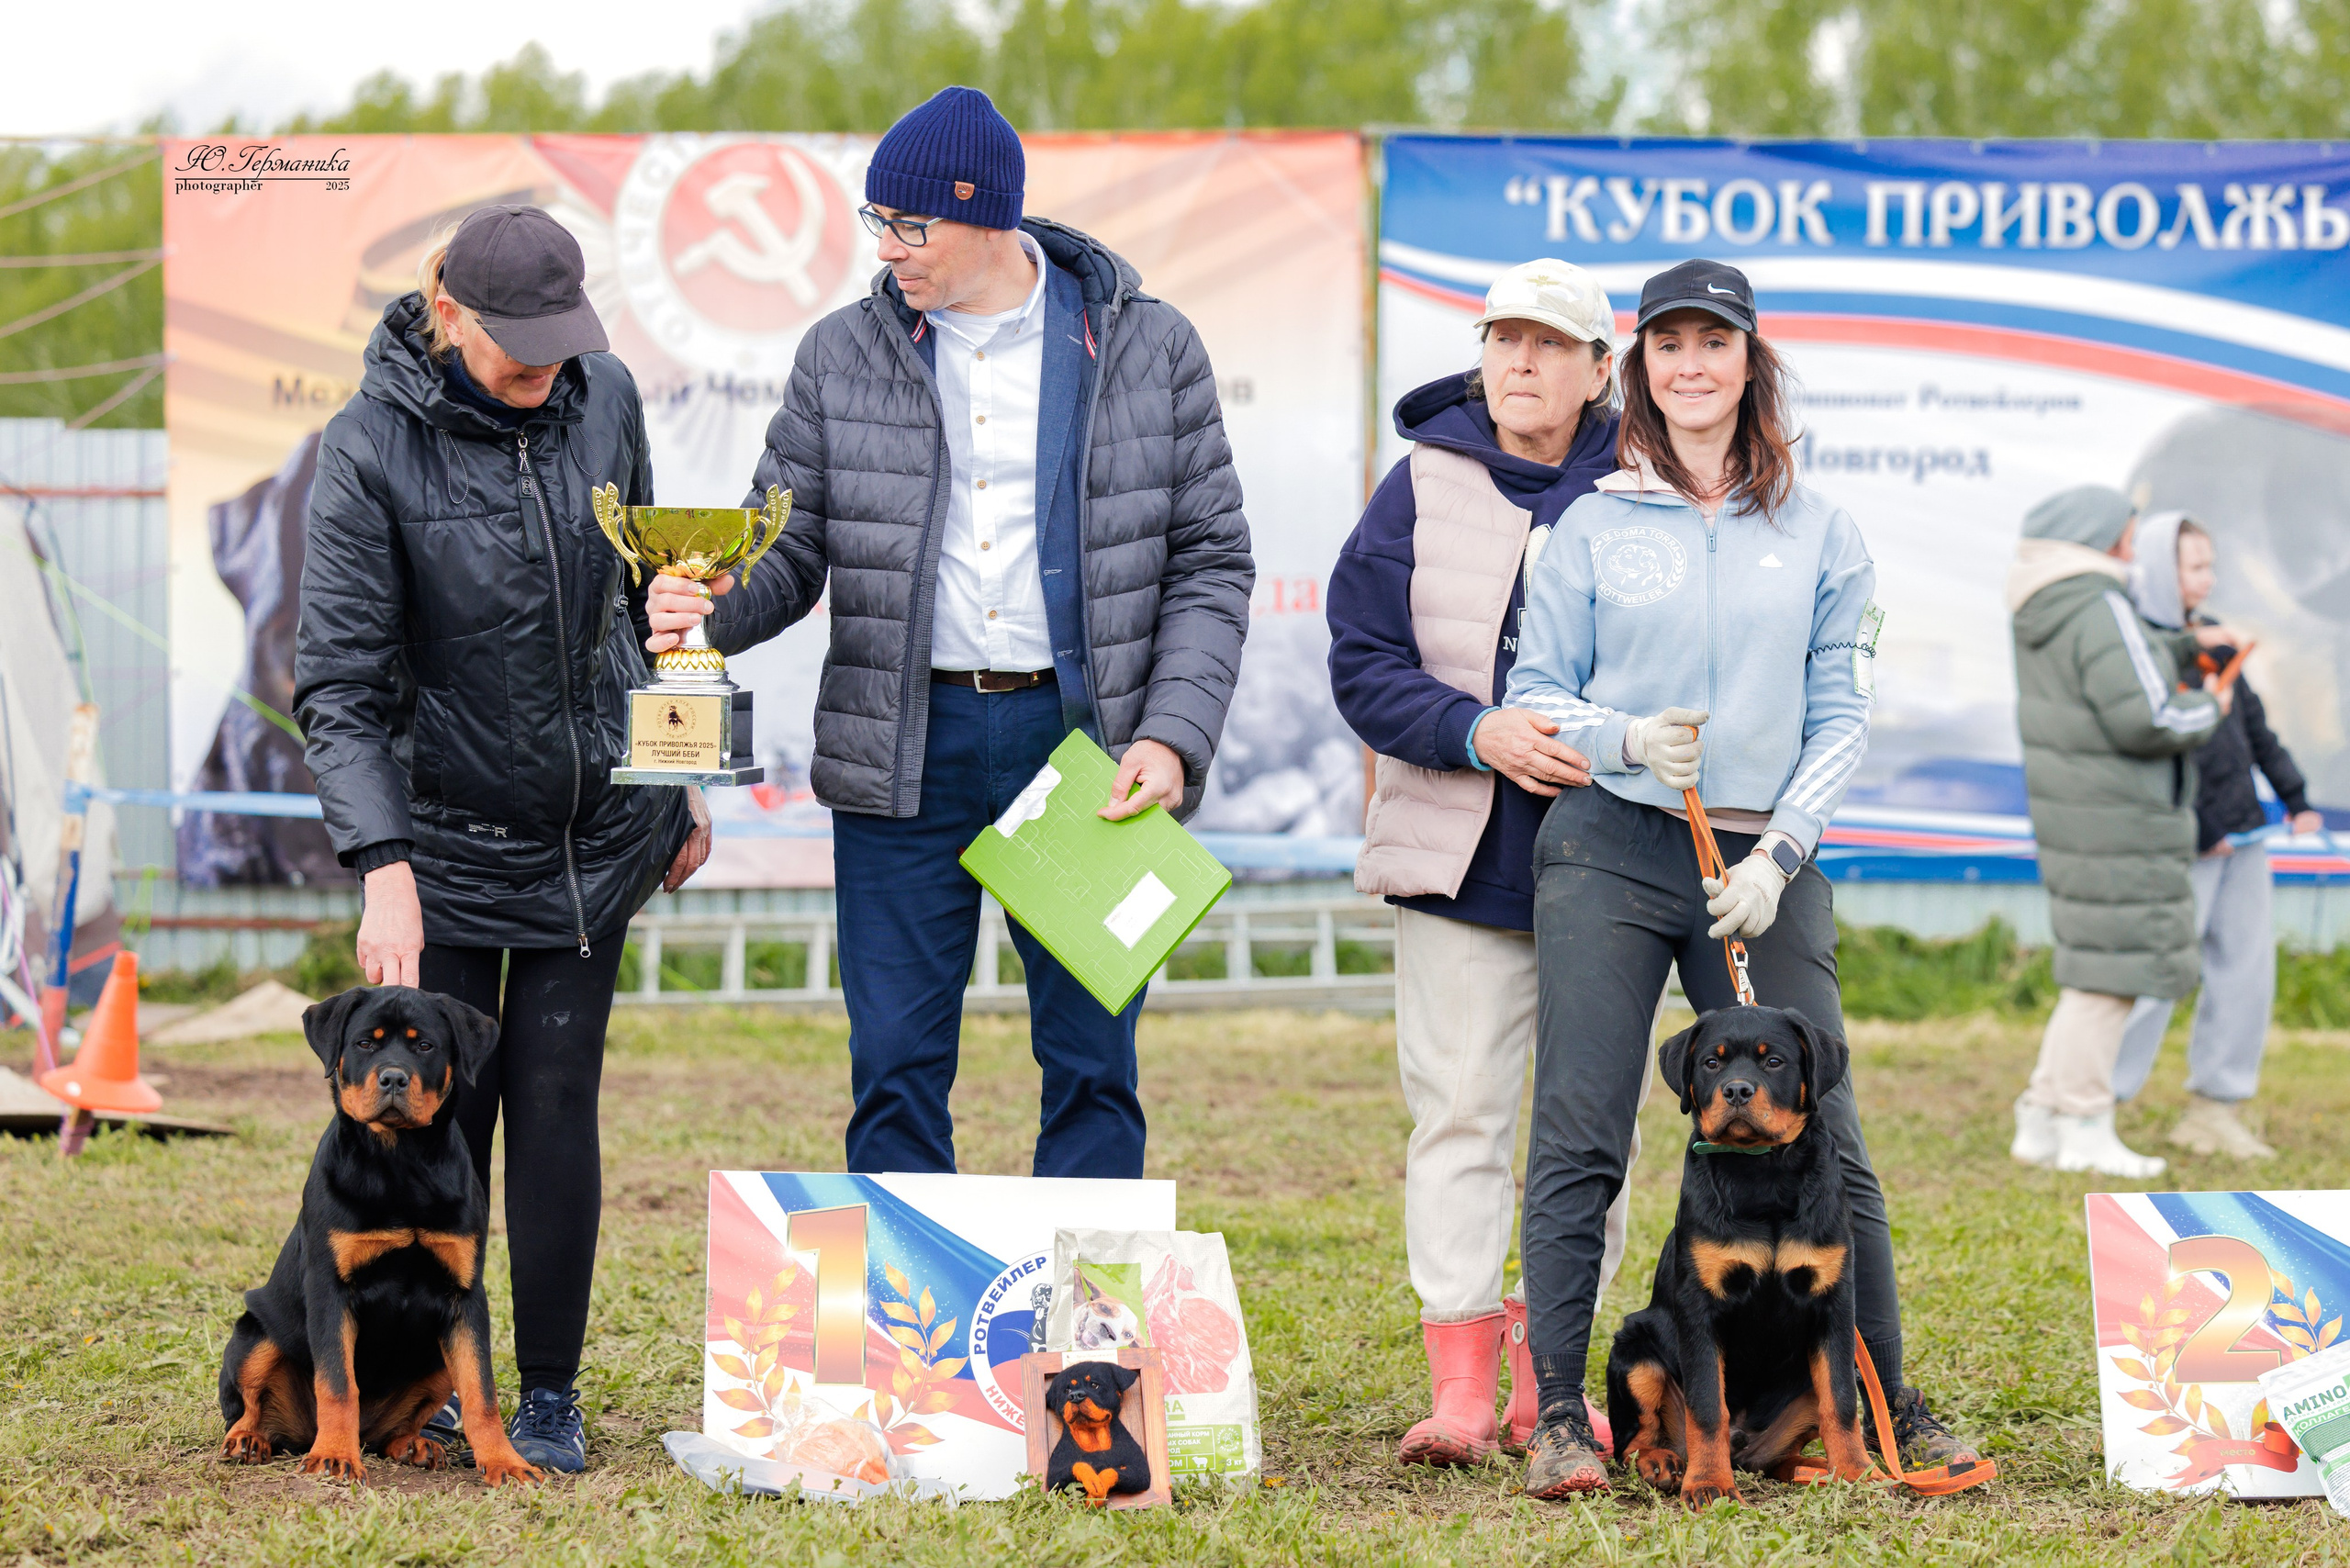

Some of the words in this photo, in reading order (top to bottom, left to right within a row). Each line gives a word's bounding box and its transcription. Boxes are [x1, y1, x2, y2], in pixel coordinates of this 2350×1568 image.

[1601, 533, 1613, 543] IZ
[1613, 528, 1646, 538] DOMA
[1650, 530, 1681, 553] TORRA
[1597, 582, 1664, 604] ROTTWEILER
[651, 749, 681, 757] ЛУЧШИЙ
[787, 1203, 869, 1386] 1
[974, 1256, 1047, 1355] РОТВЕЙЛЕР
[2168, 1234, 2283, 1385] 2
[2283, 1385, 2347, 1421] AMINO
[1226, 1458, 1232, 1466] 3
